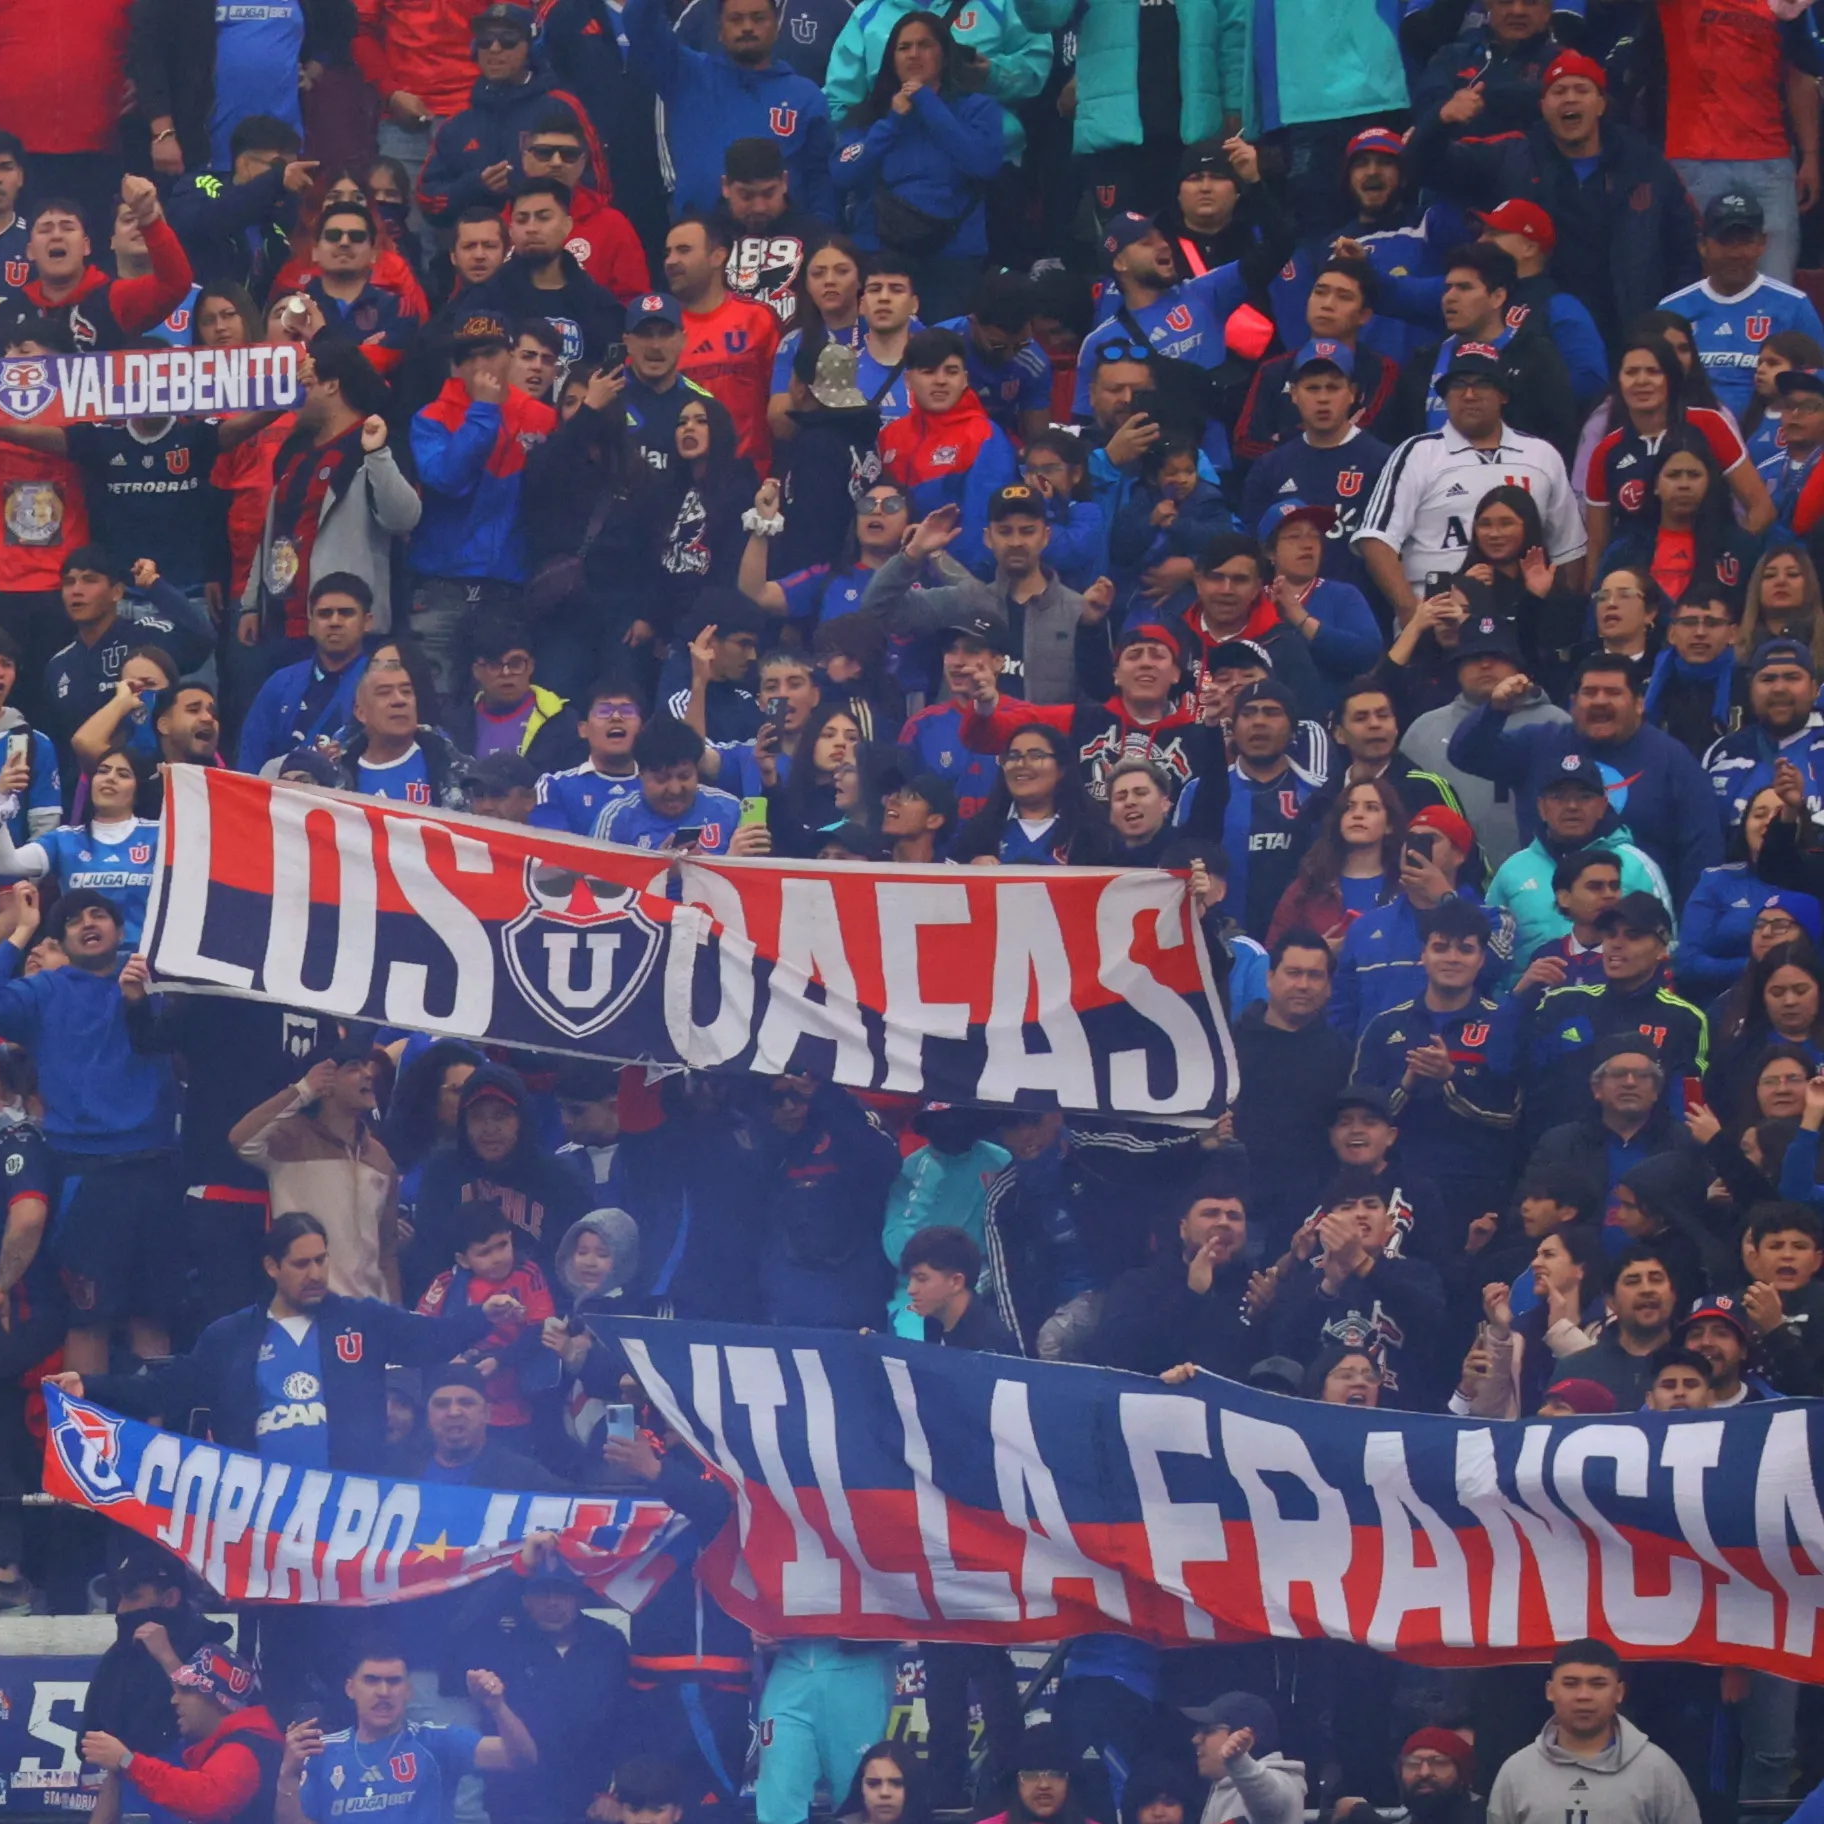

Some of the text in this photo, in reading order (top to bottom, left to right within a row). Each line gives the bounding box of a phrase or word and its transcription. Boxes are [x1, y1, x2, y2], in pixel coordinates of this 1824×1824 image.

[57, 346, 298, 417] VALDEBENITO
[156, 766, 492, 1038] LOS
[1119, 1391, 1824, 1661] FRANCIA
